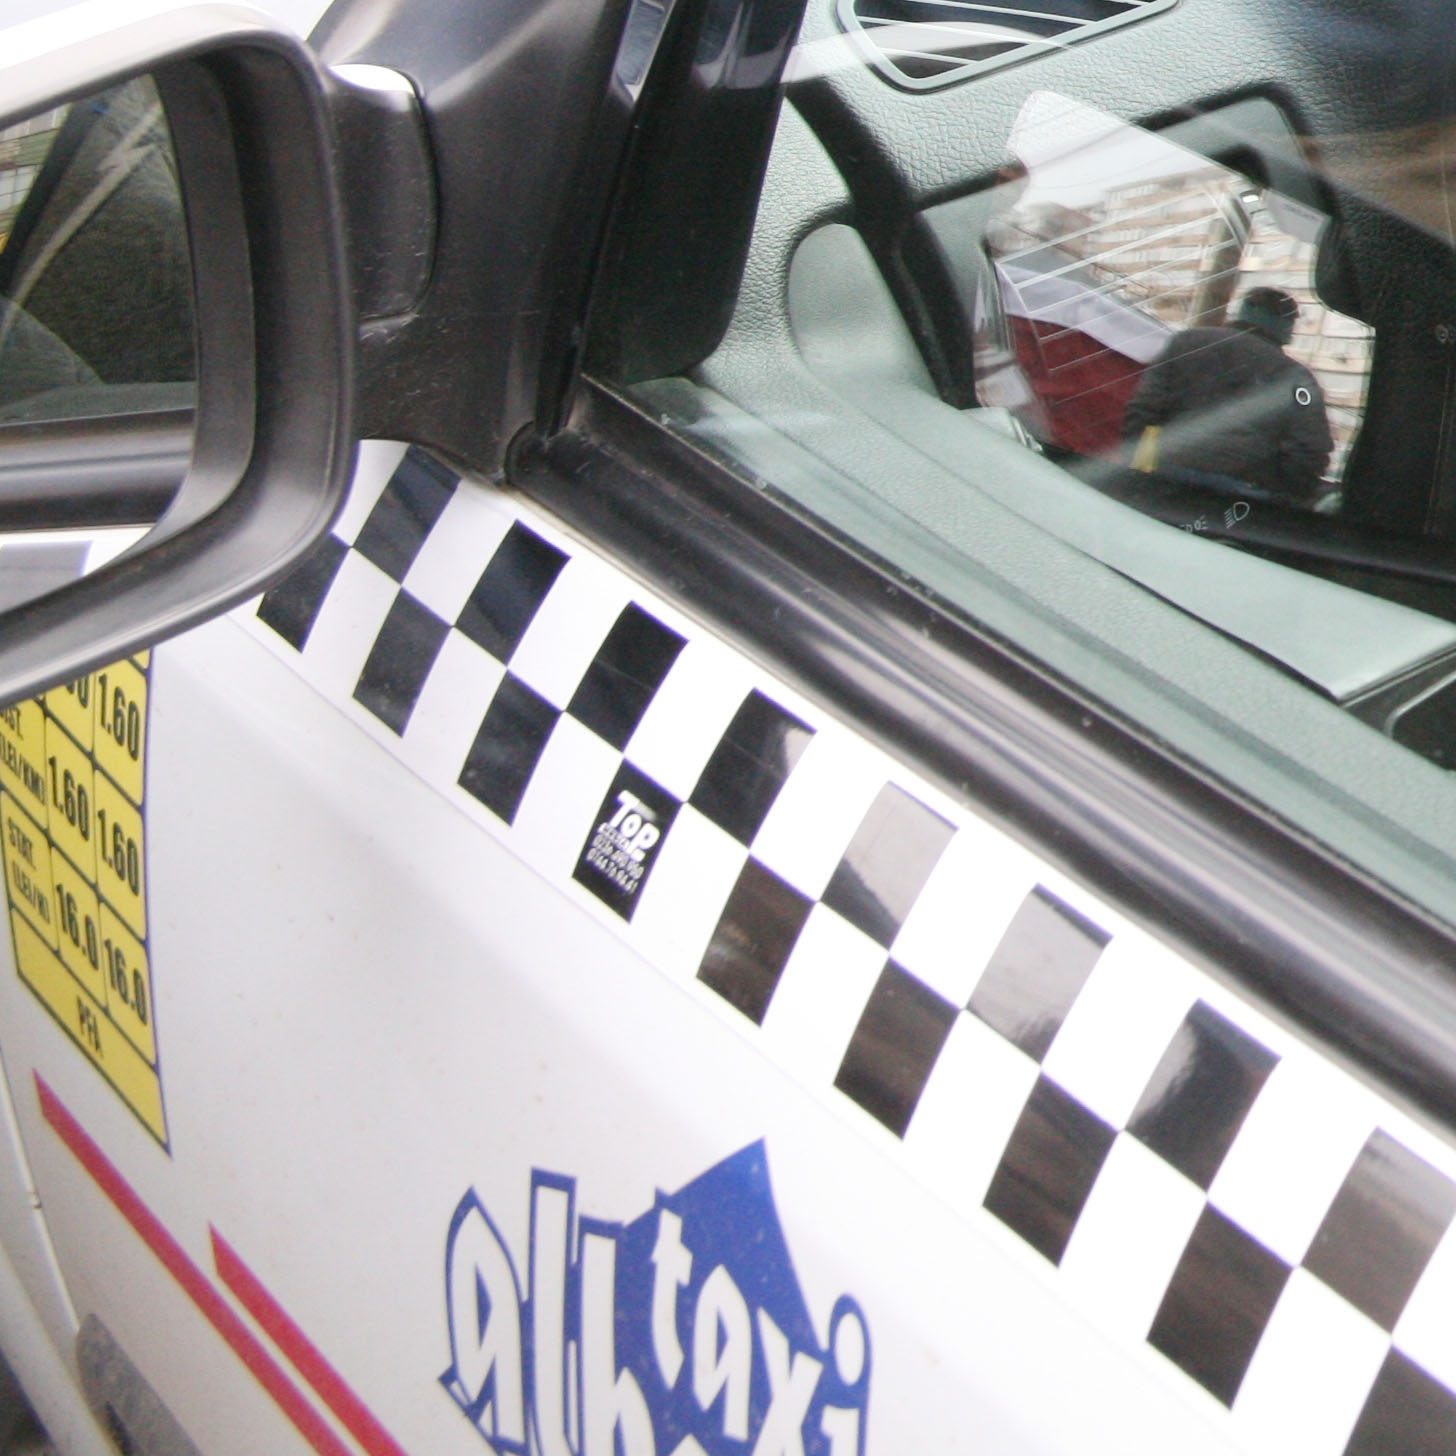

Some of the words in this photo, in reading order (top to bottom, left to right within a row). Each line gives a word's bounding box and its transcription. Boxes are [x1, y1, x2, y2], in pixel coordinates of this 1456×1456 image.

[99, 674, 139, 761] 1.60
[48, 756, 88, 841] 1.60
[98, 809, 139, 896] 1.60
[57, 884, 99, 970] 16.0
[104, 939, 147, 1025] 16.0
